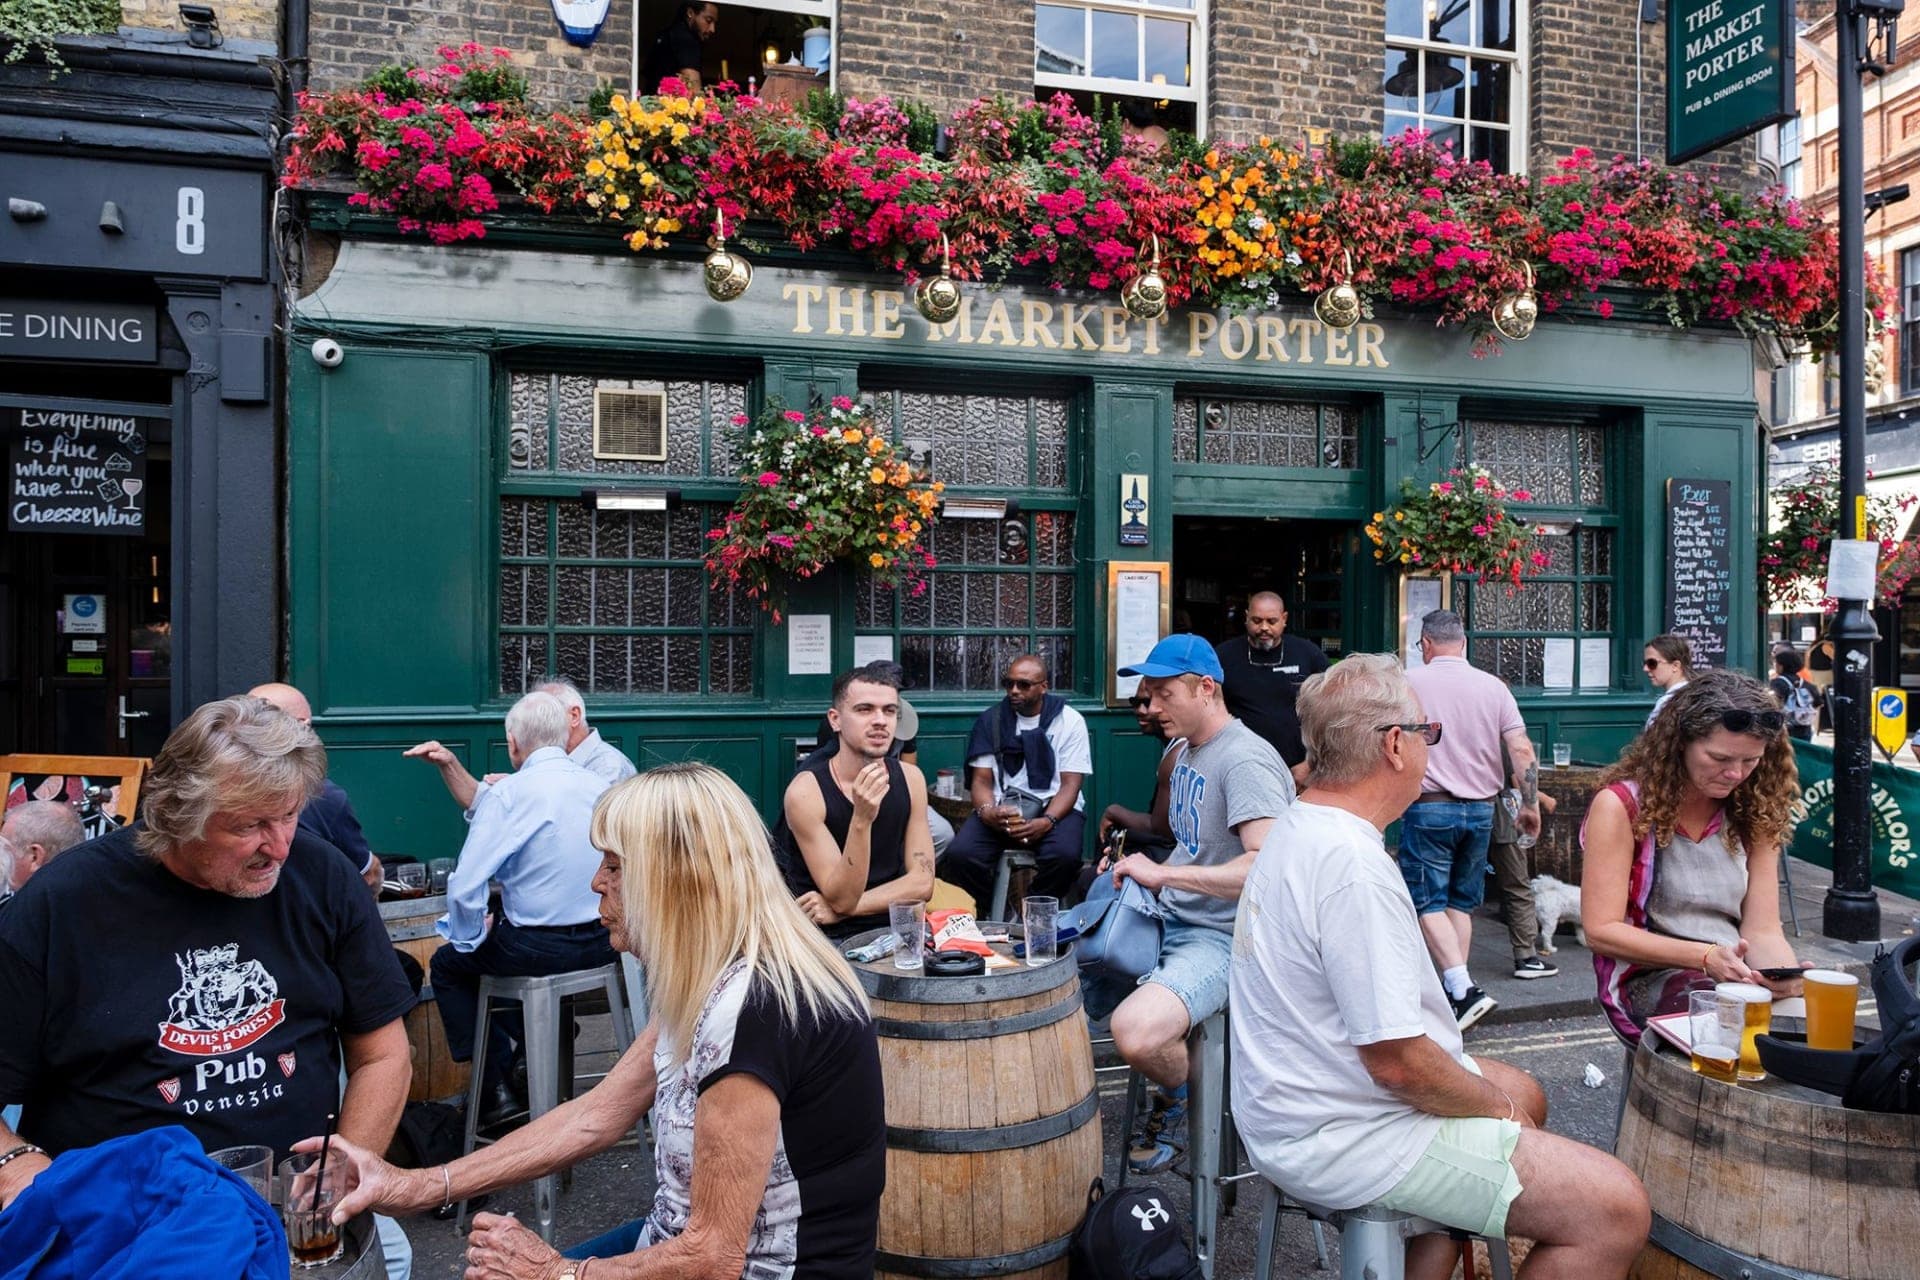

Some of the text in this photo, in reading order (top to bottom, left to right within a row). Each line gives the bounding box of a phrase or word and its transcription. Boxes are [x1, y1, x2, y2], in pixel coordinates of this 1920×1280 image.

[1686, 0, 1724, 33] THE
[1686, 4, 1765, 62] MARKET
[1686, 35, 1765, 89] PORTER
[1685, 66, 1773, 115] PUB & DINING ROOM
[176, 186, 205, 255] 8
[25, 314, 142, 343] DINING
[783, 284, 1390, 368] THE MARKET PORTER
[21, 409, 136, 443] Everything
[24, 435, 98, 463] is fine
[15, 459, 108, 489] when you
[1680, 484, 1712, 503] Beer
[1871, 782, 1918, 869] AYLOR'S
[223, 1008, 274, 1042] FOREST
[211, 1043, 233, 1053] PUB
[196, 1051, 266, 1092] Pub
[183, 1081, 284, 1116] Venezia
